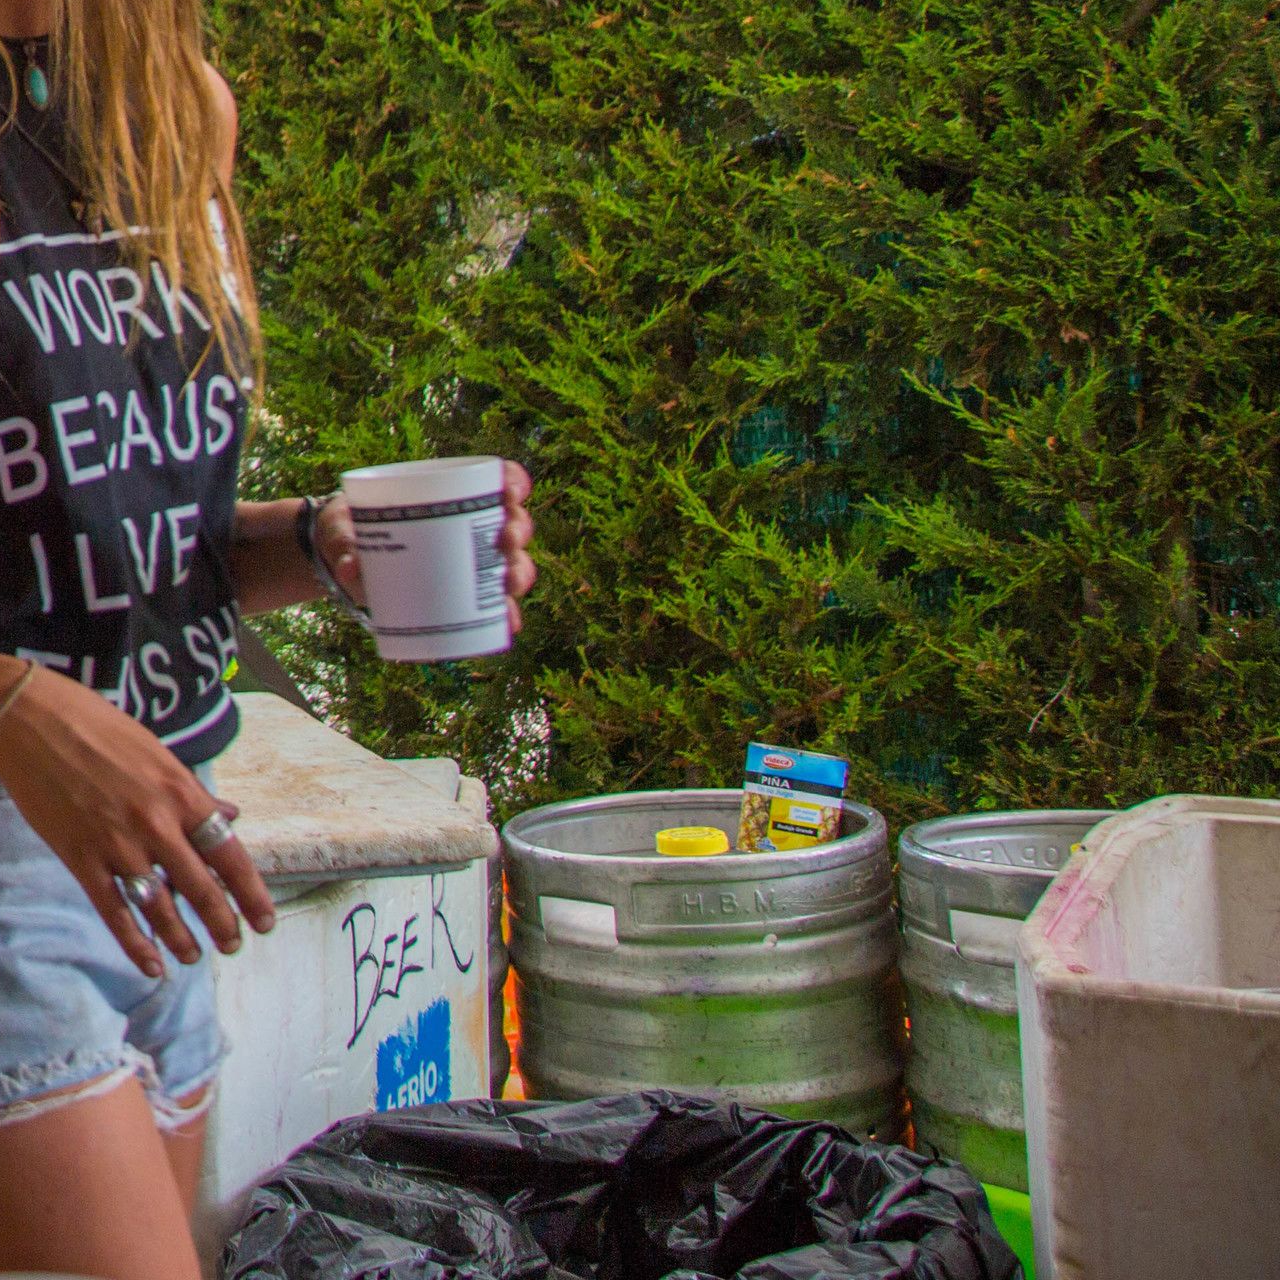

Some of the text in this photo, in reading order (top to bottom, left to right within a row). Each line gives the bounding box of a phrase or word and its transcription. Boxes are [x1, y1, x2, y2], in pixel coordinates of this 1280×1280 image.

[1, 261, 213, 354] WORK
[30, 532, 53, 614] I
[761, 775, 791, 790] PIÑA
[341, 872, 474, 1050] BEER
